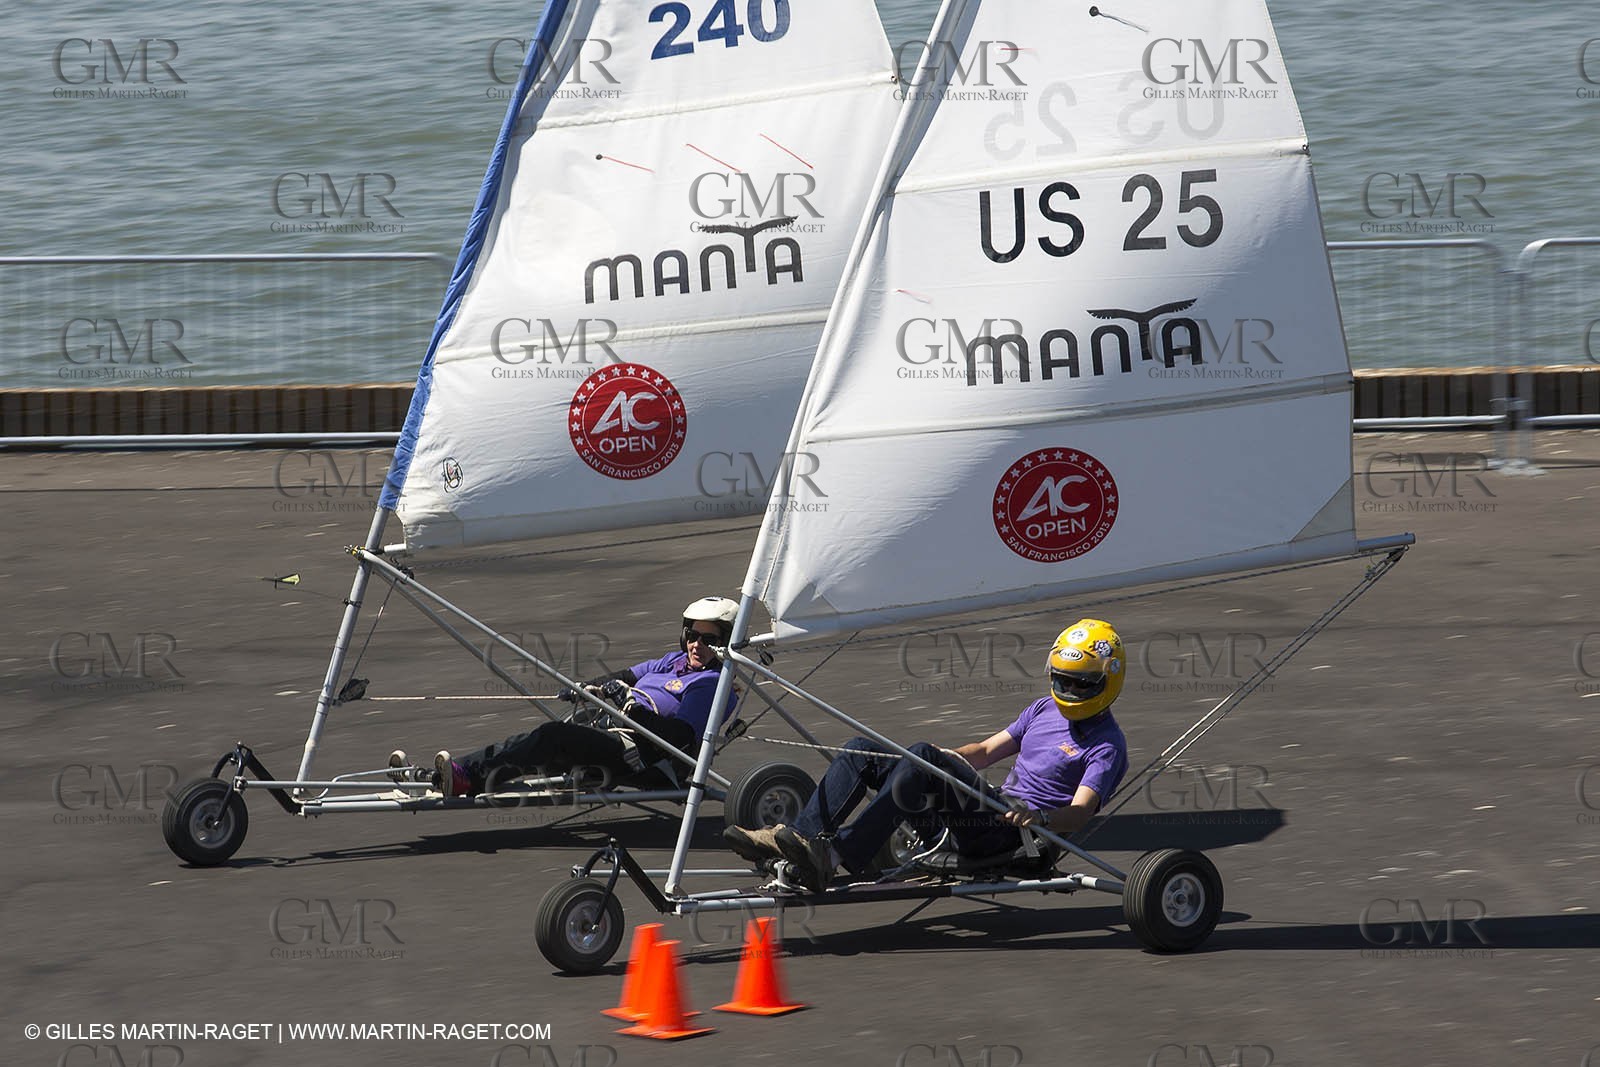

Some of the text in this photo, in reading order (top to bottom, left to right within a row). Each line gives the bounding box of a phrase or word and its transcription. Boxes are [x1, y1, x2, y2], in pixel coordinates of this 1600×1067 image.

[648, 0, 790, 60] 240
[979, 169, 1223, 263] US 25
[590, 391, 660, 434] AC
[581, 442, 679, 478] SAN FRANCISCO 2013
[599, 436, 656, 454] OPEN
[1016, 475, 1090, 521] AC
[1007, 521, 1111, 561] SAN FRANCISCO 2013
[1025, 517, 1087, 539] OPEN
